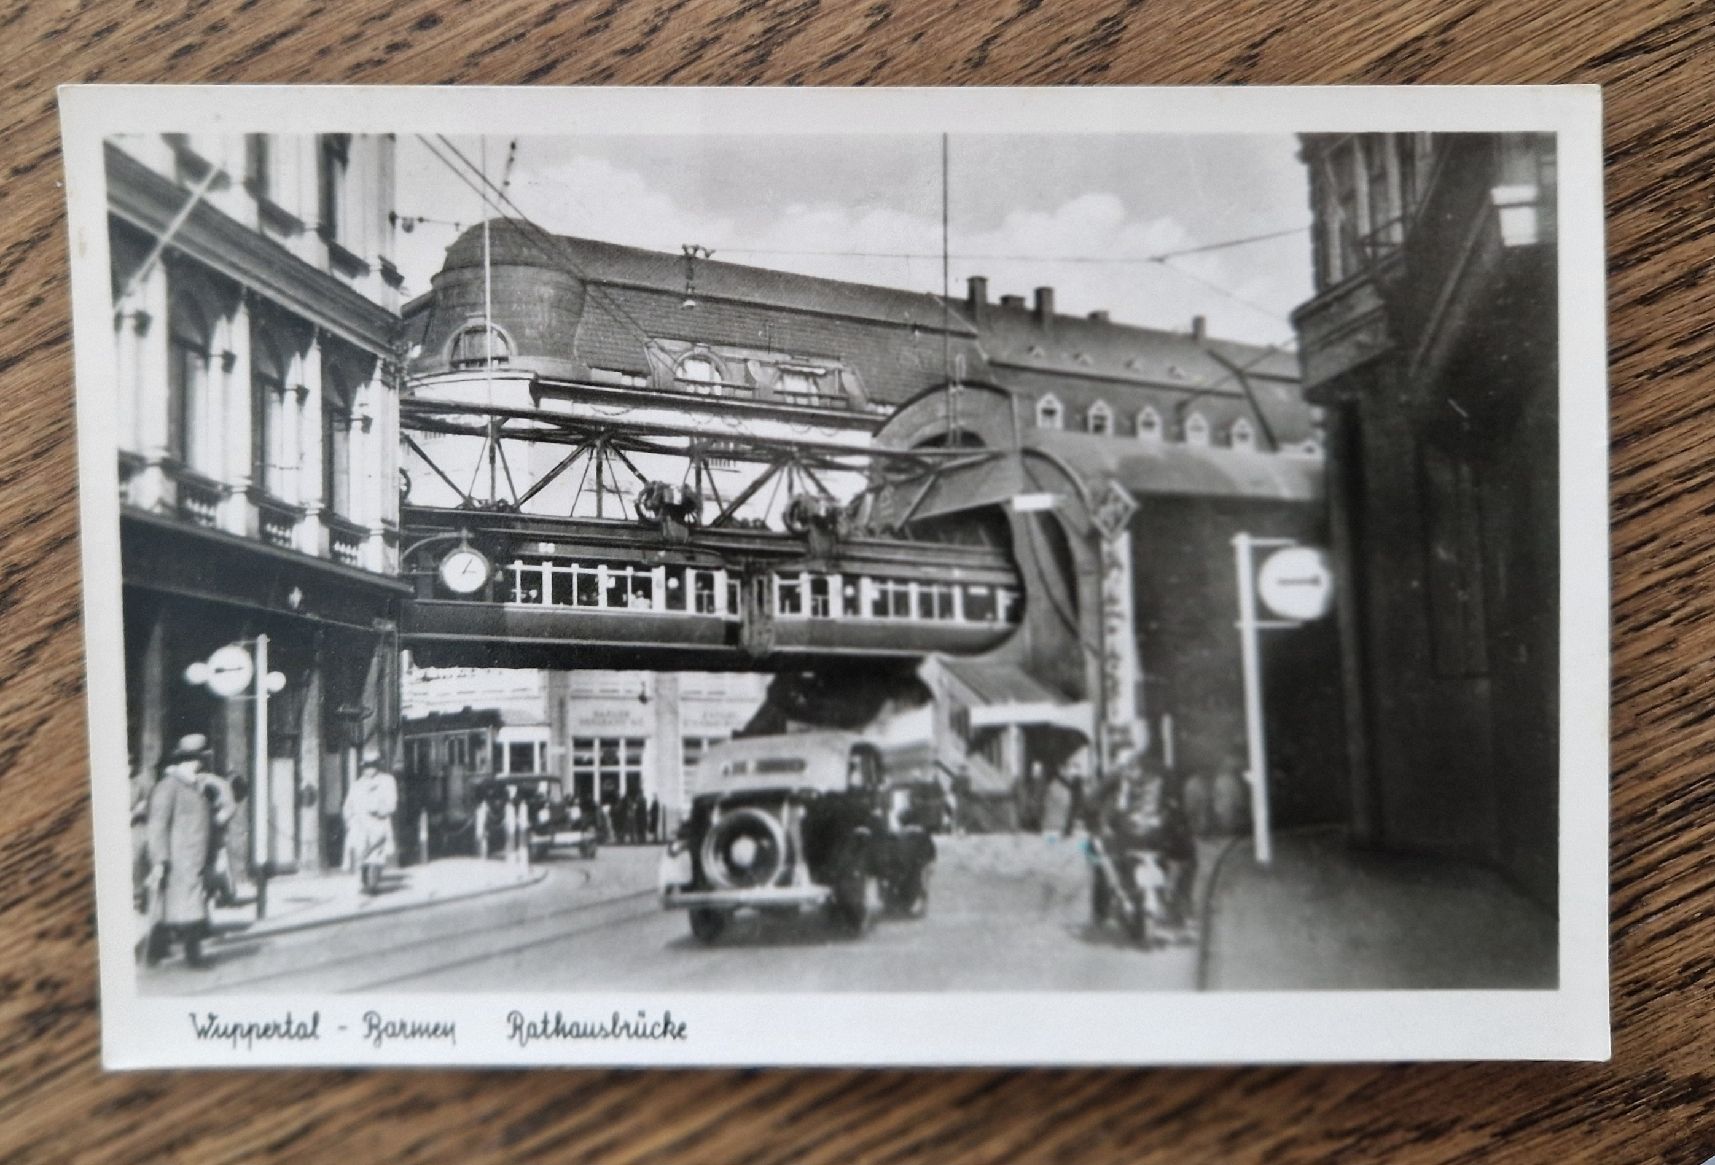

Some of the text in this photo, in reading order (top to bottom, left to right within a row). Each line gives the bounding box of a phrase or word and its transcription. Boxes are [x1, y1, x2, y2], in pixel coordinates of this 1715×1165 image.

[190, 1010, 321, 1051] Wuppertal
[362, 1010, 457, 1049] Barmen
[506, 1010, 689, 1047] Rathausbrücke
